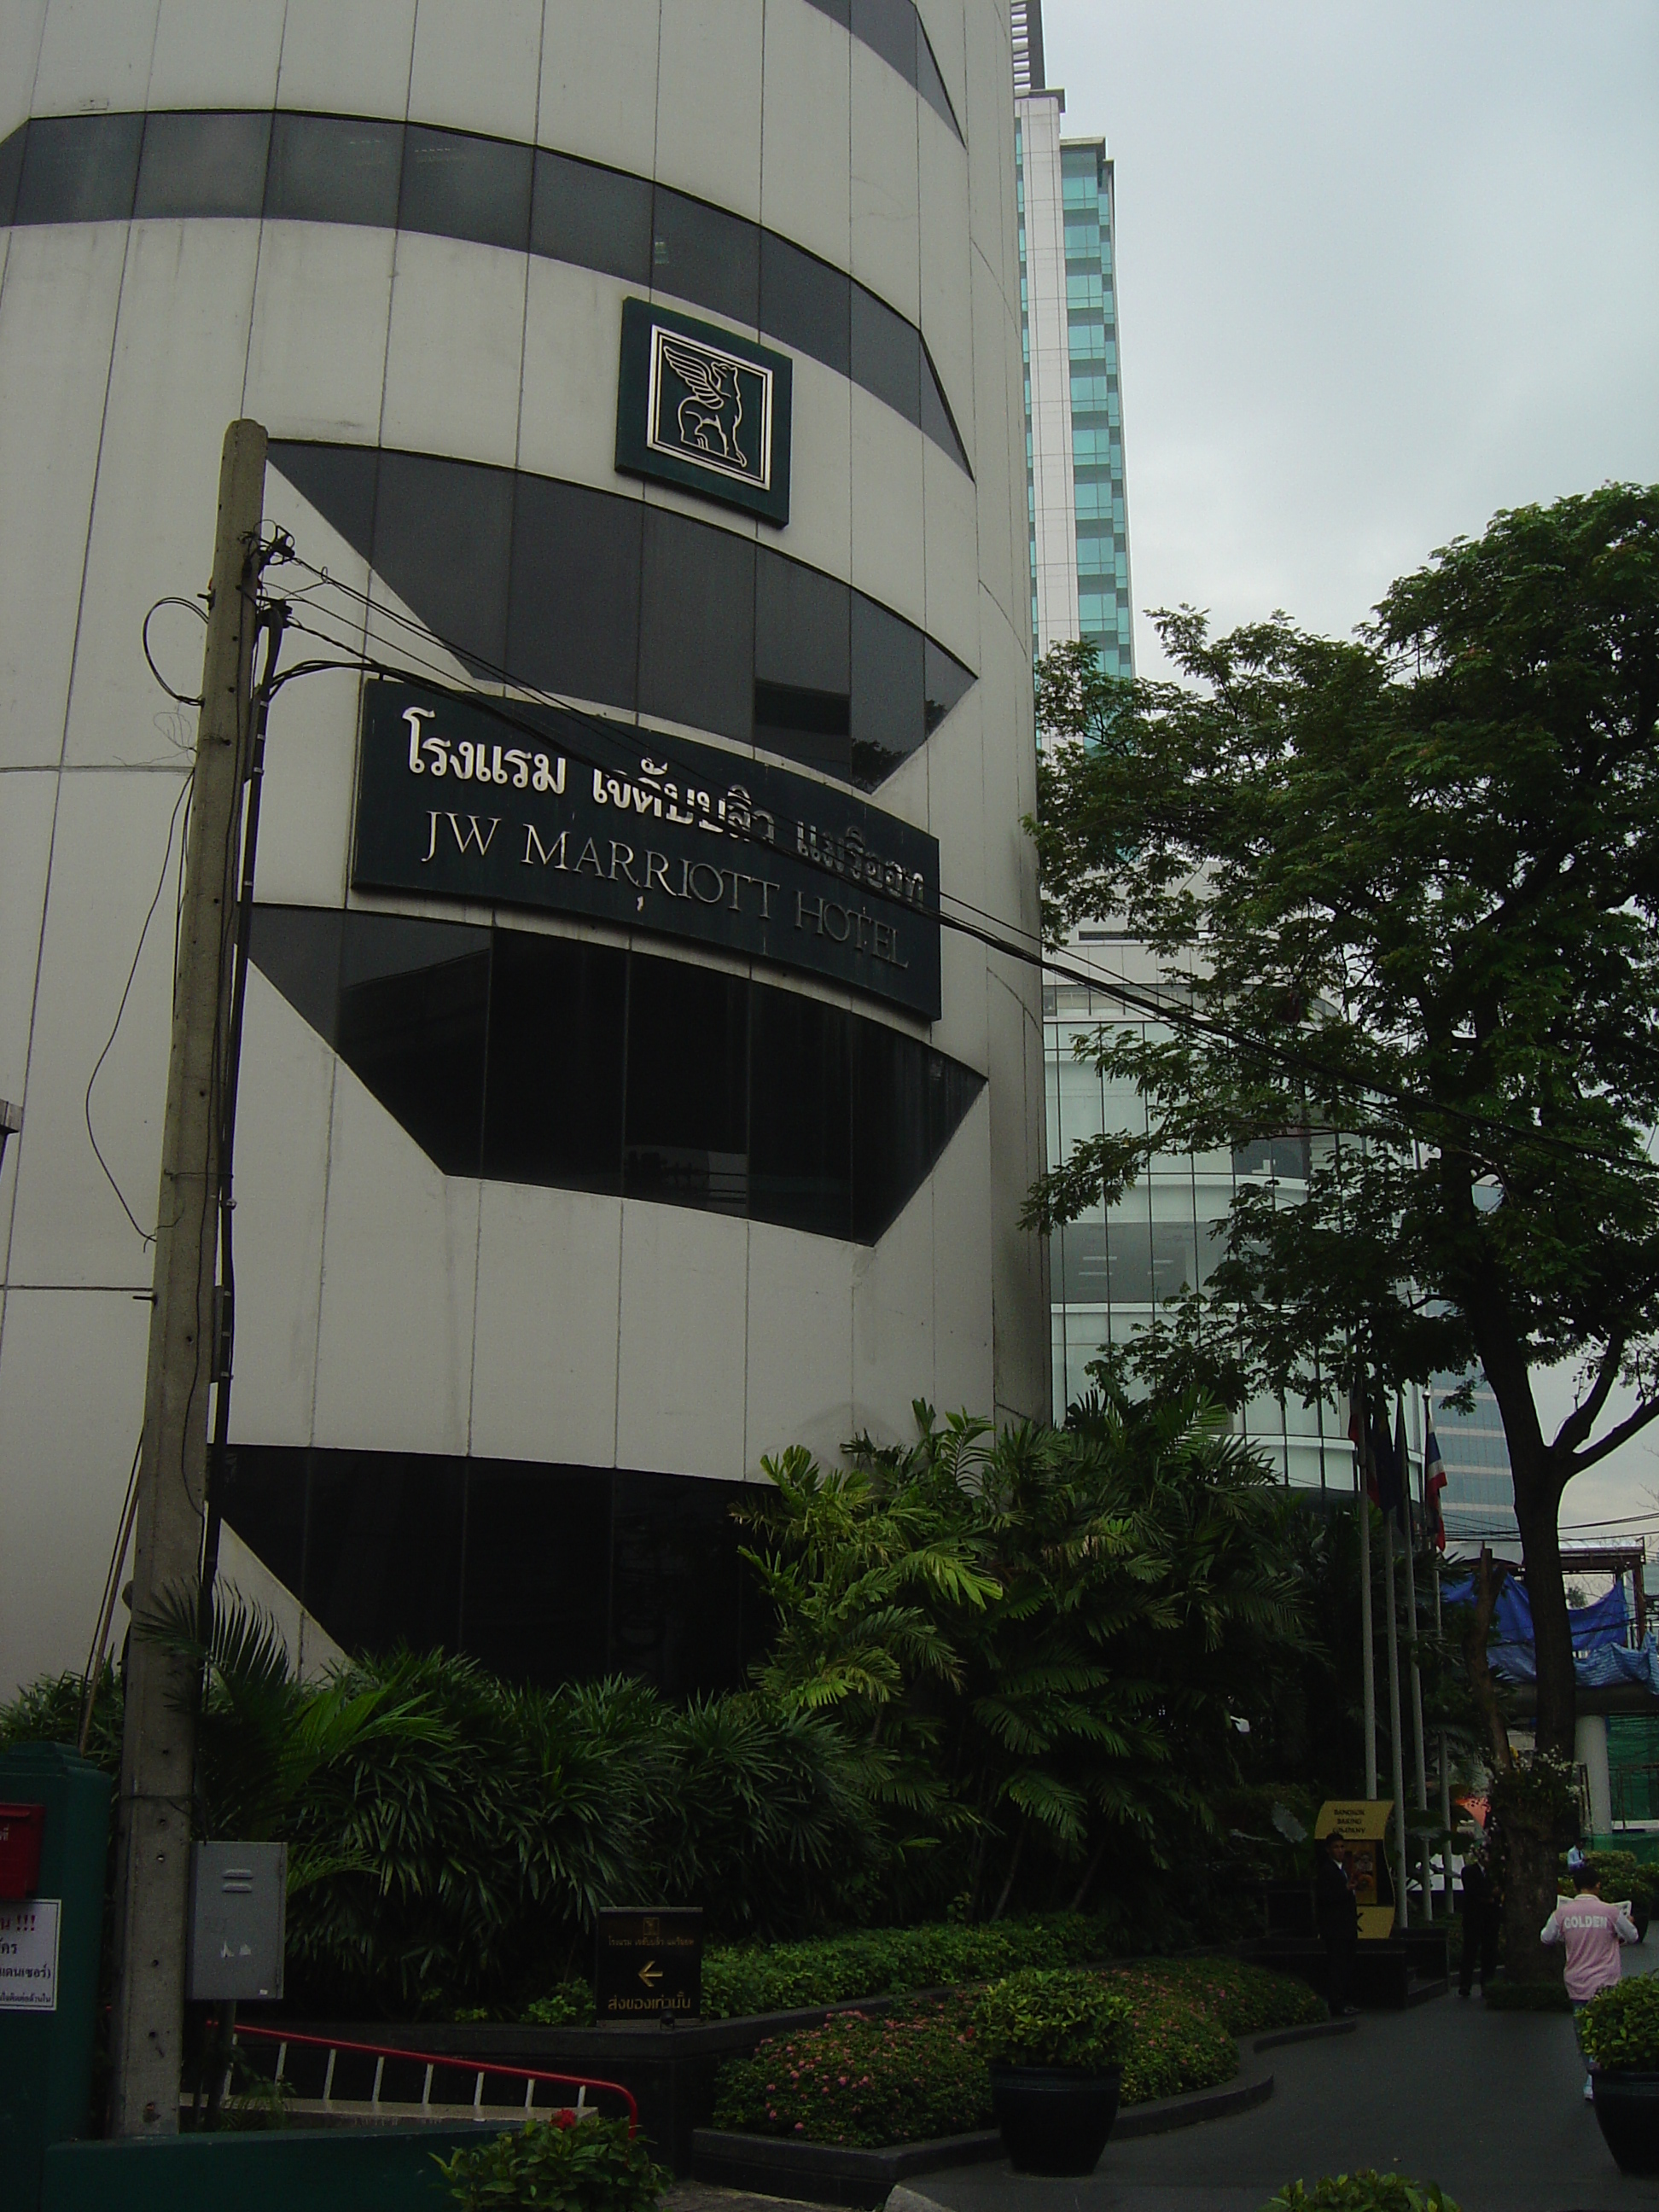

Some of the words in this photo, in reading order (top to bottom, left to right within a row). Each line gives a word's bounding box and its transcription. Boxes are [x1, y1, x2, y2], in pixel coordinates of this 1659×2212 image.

[401, 706, 568, 795] โรงแรม
[421, 810, 502, 863] JW
[521, 823, 780, 919] MARRIOTT
[794, 890, 909, 969] HOTEL
[1563, 1916, 1608, 1929] GOLDEN
[608, 1990, 691, 2011] ส่งของเท่านั้น
